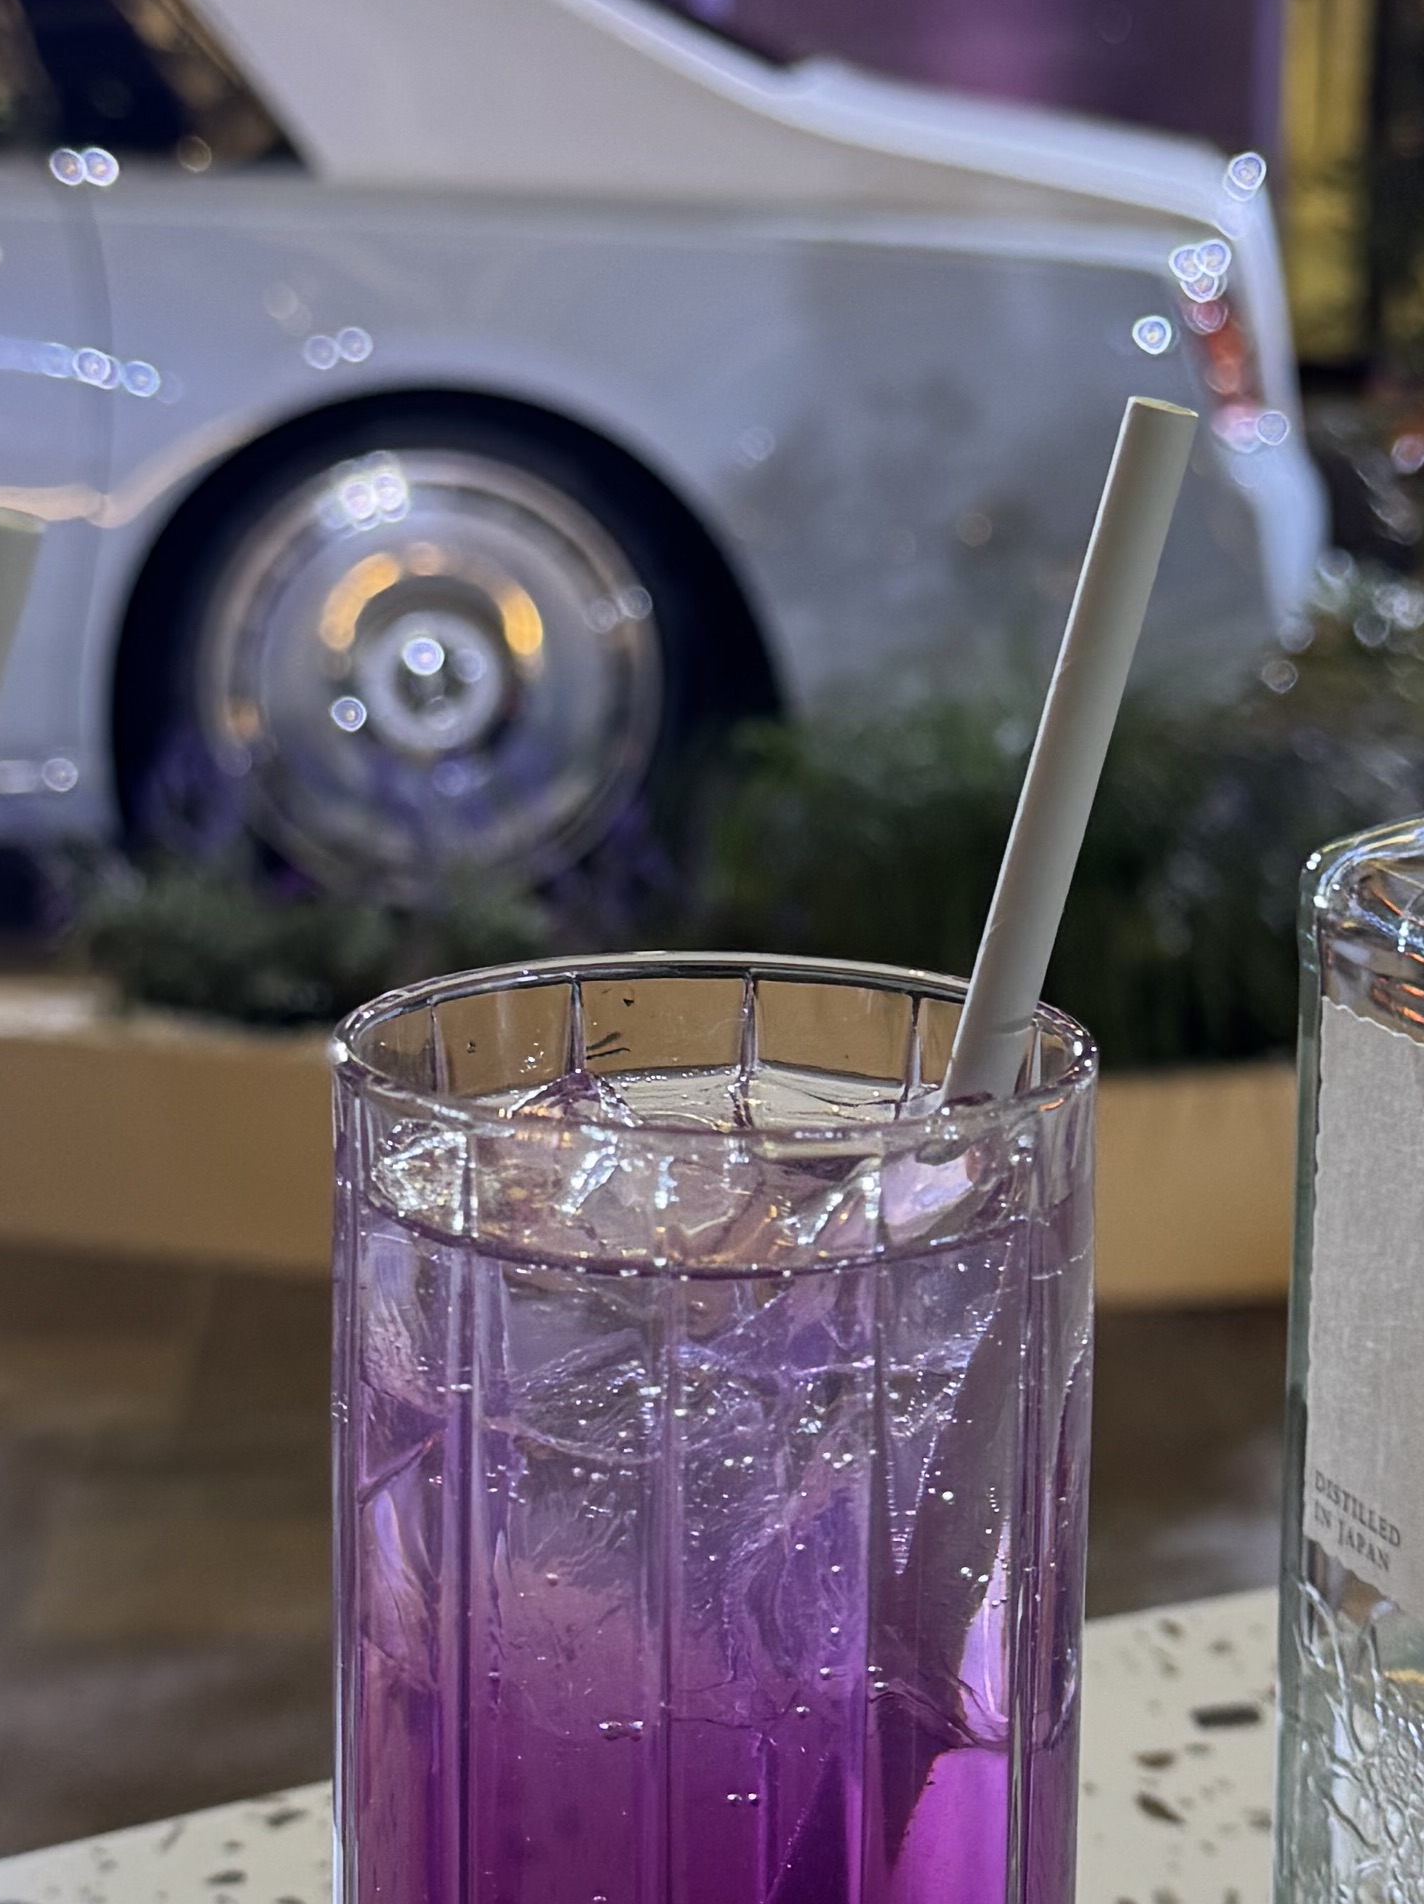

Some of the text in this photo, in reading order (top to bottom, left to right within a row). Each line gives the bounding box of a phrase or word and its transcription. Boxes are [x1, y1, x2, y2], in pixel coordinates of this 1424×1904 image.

[1315, 1469, 1401, 1548] DISTILLED
[1315, 1499, 1390, 1573] IN JAPAN
